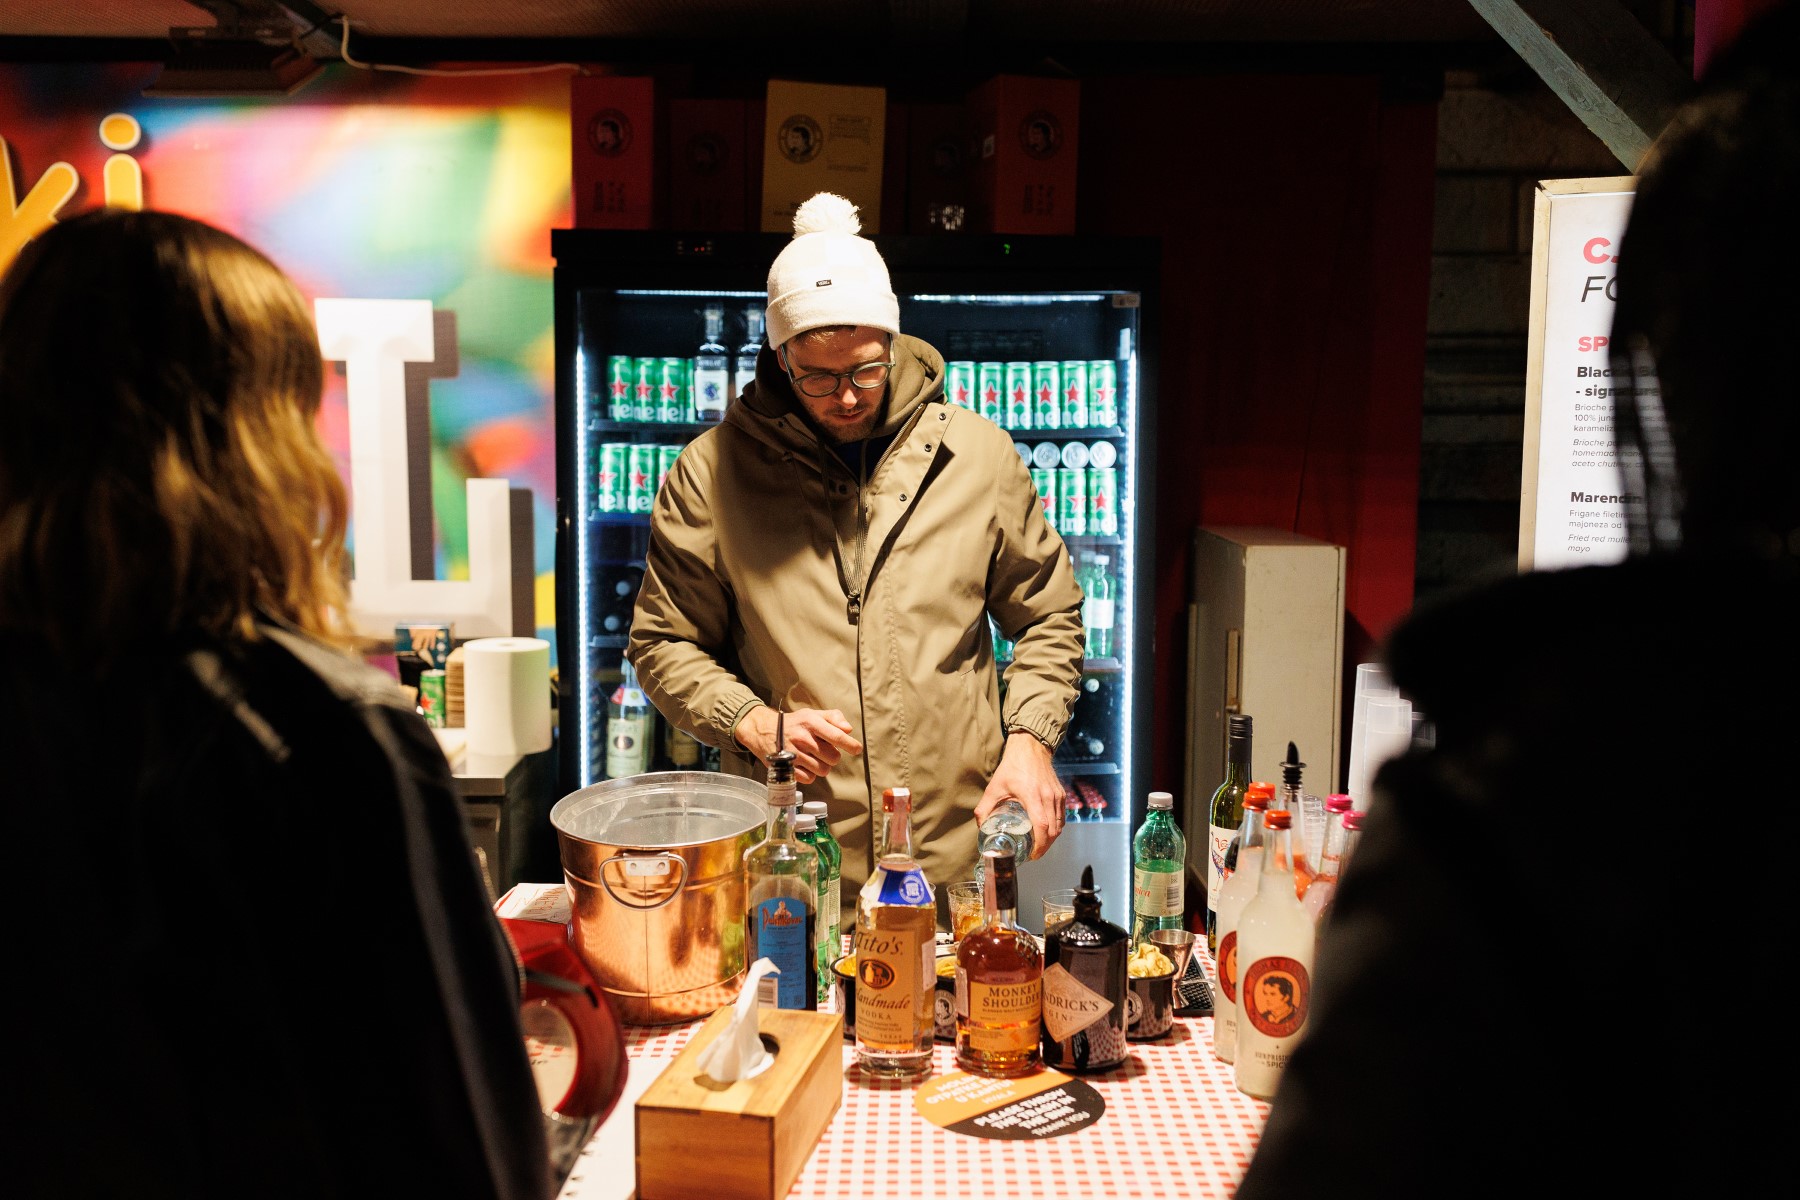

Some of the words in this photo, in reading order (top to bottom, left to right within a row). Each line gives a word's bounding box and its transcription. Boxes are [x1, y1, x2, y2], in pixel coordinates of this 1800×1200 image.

[1583, 237, 1619, 264] C
[1575, 414, 1596, 422] 100%
[1572, 439, 1605, 447] Brioche
[1569, 509, 1601, 518] Frigane
[1568, 521, 1609, 529] majoneza
[1611, 521, 1622, 529] od
[1567, 533, 1590, 541] Fried
[1591, 535, 1606, 543] red
[989, 982, 1038, 998] MONKEY
[861, 1008, 892, 1020] VODKA
[1048, 1009, 1068, 1021] GIN
[973, 1104, 1025, 1127] PLEASE
[1019, 1088, 1067, 1109] THROW
[991, 1115, 1022, 1129] THE
[1016, 1100, 1062, 1120] TRASH
[1056, 1094, 1077, 1106] IN
[1018, 1114, 1049, 1129] THE
[1031, 1119, 1070, 1136] THANK
[1065, 1110, 1091, 1123] YOU
